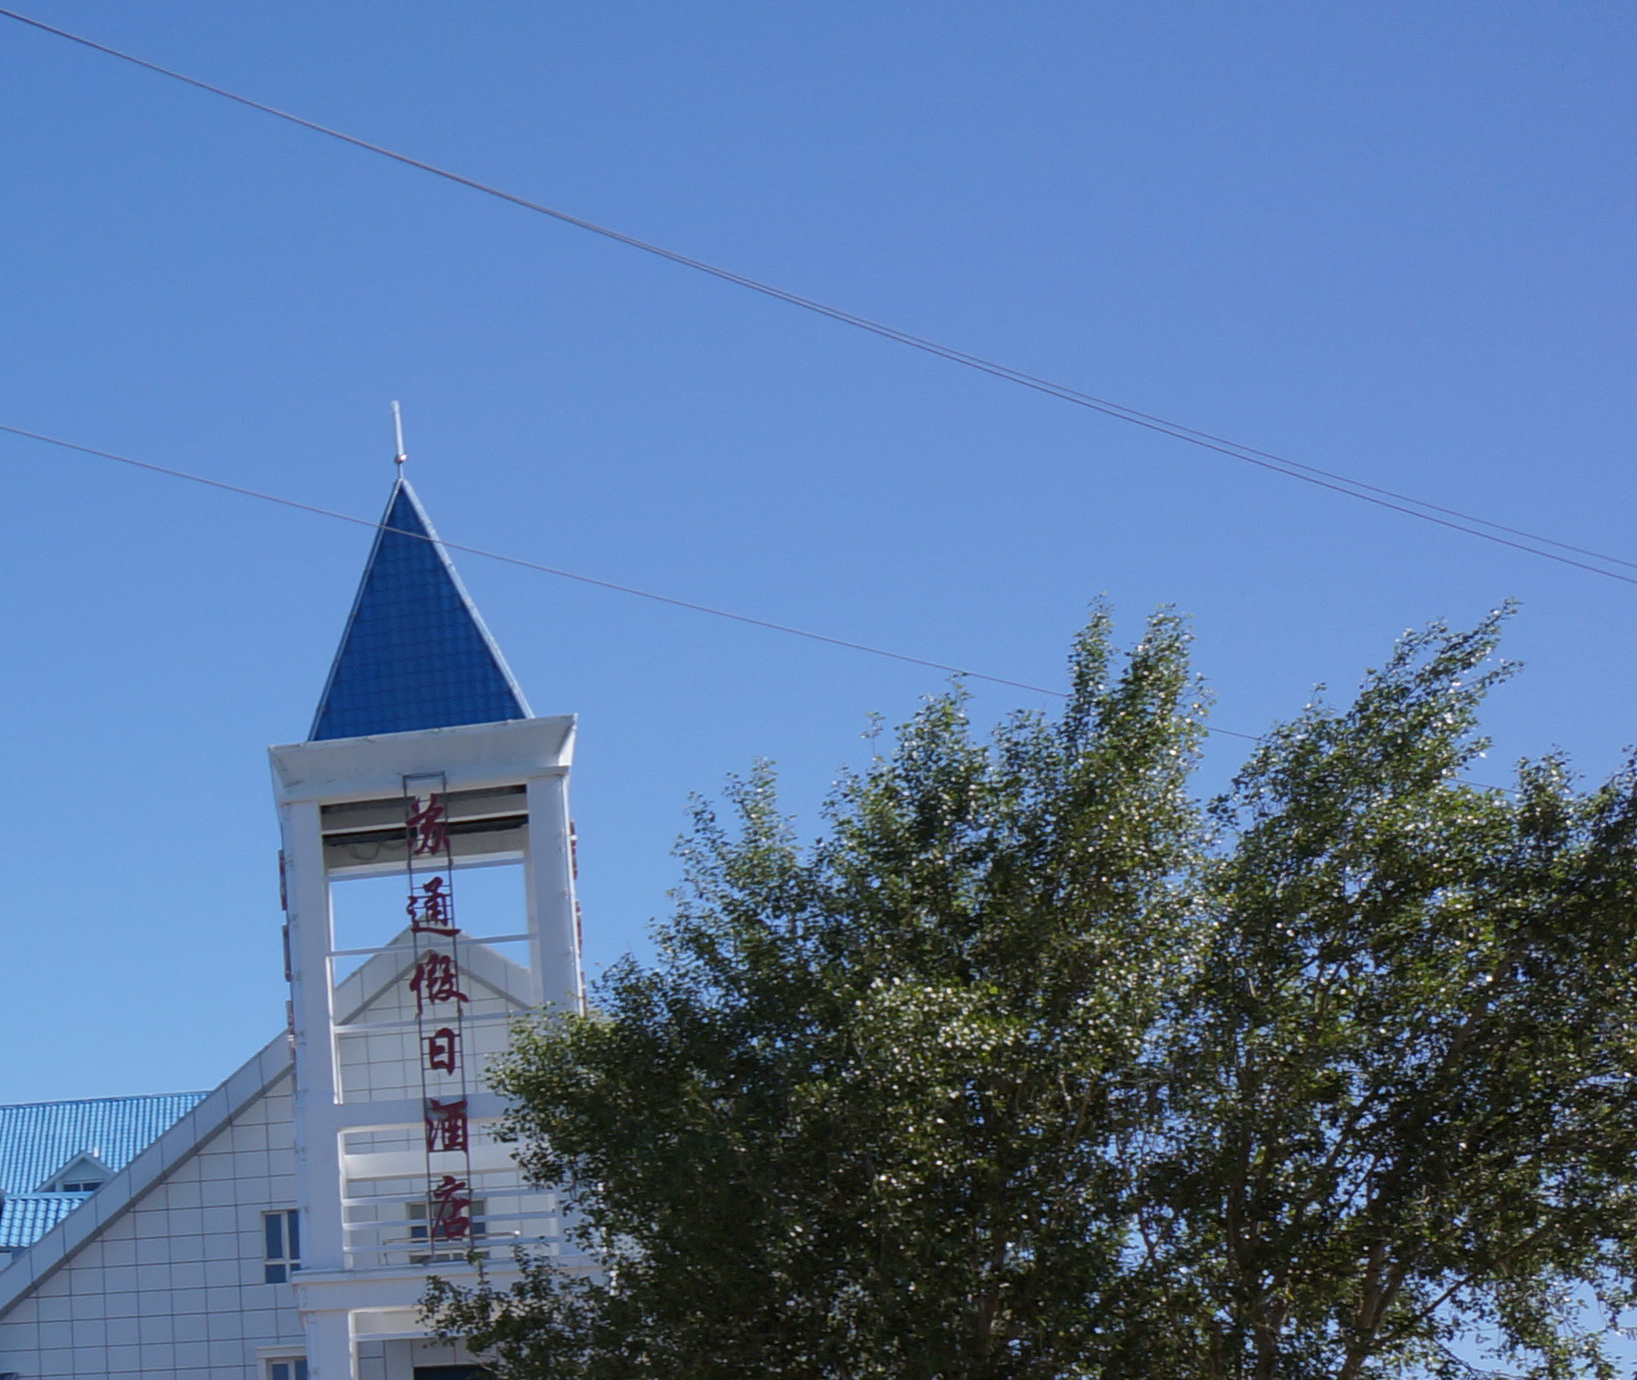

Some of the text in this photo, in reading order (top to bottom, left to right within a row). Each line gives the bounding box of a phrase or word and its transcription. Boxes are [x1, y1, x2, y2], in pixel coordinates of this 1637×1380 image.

[406, 793, 471, 1242] 苏通假日酒店
